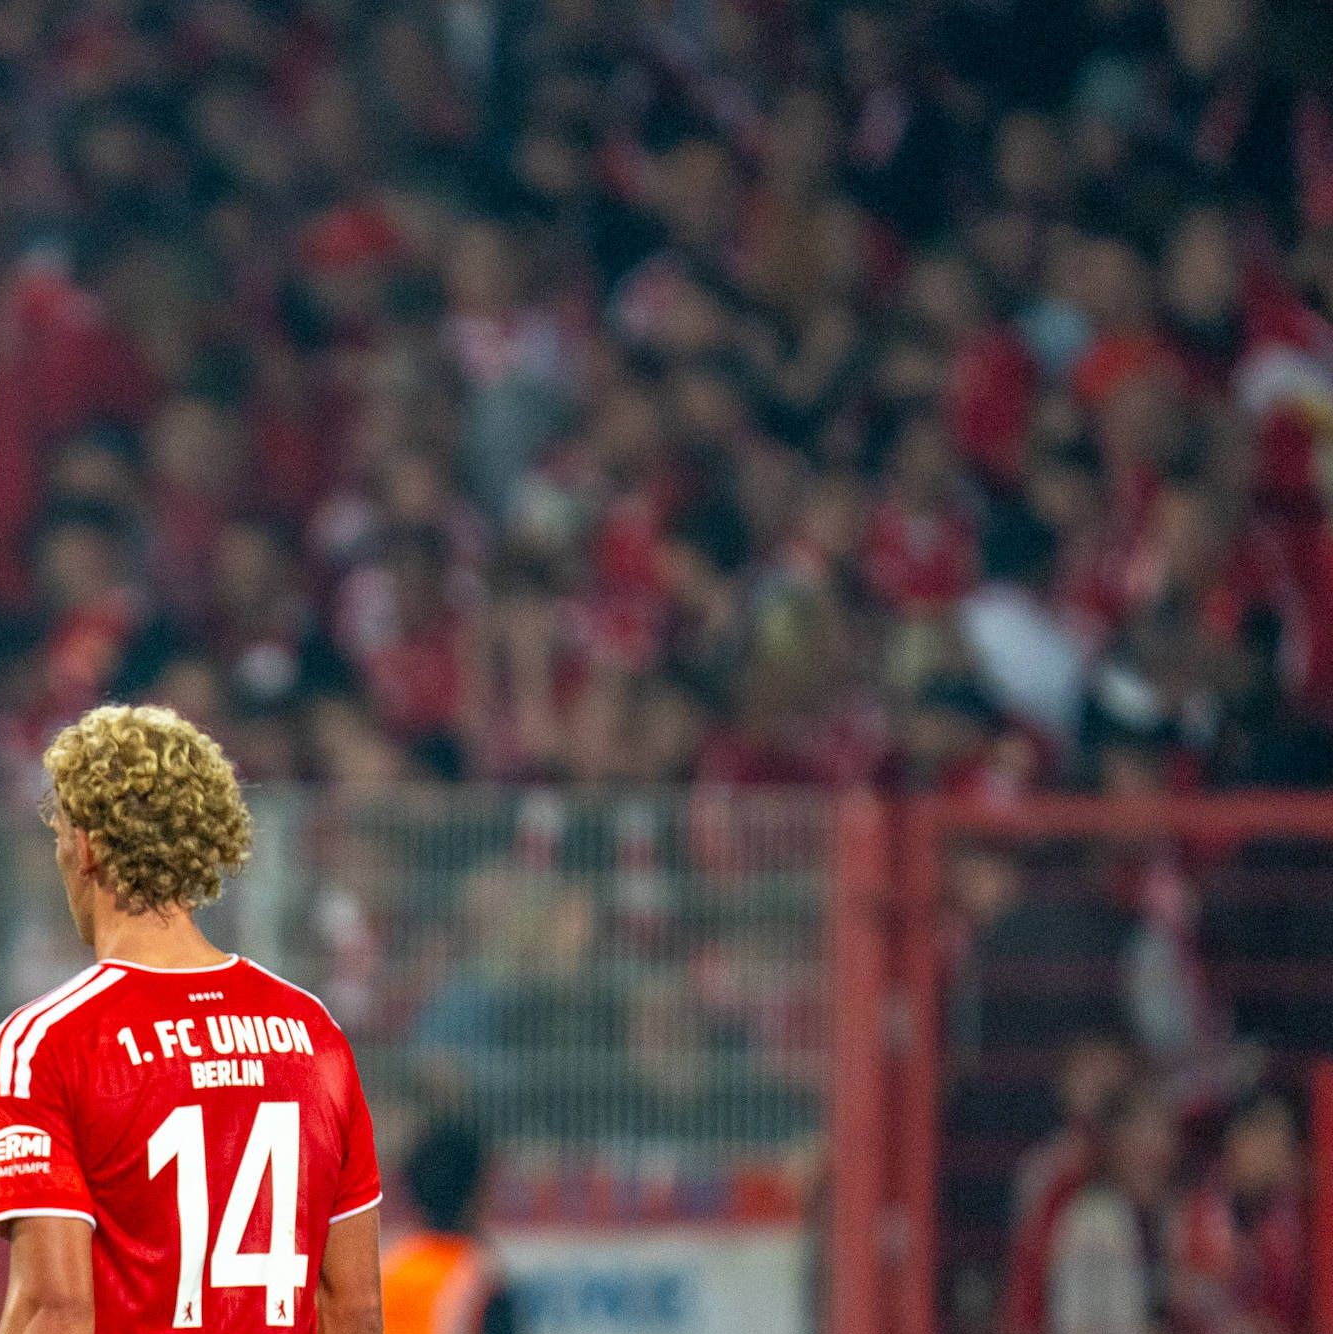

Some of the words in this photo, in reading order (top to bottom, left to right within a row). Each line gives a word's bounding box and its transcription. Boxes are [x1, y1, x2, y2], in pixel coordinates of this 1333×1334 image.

[117, 1026, 154, 1066] 1.
[154, 1019, 202, 1058] FC
[206, 1015, 314, 1056] UNION
[190, 1059, 264, 1089] BERLIN
[147, 1101, 308, 1328] 14
